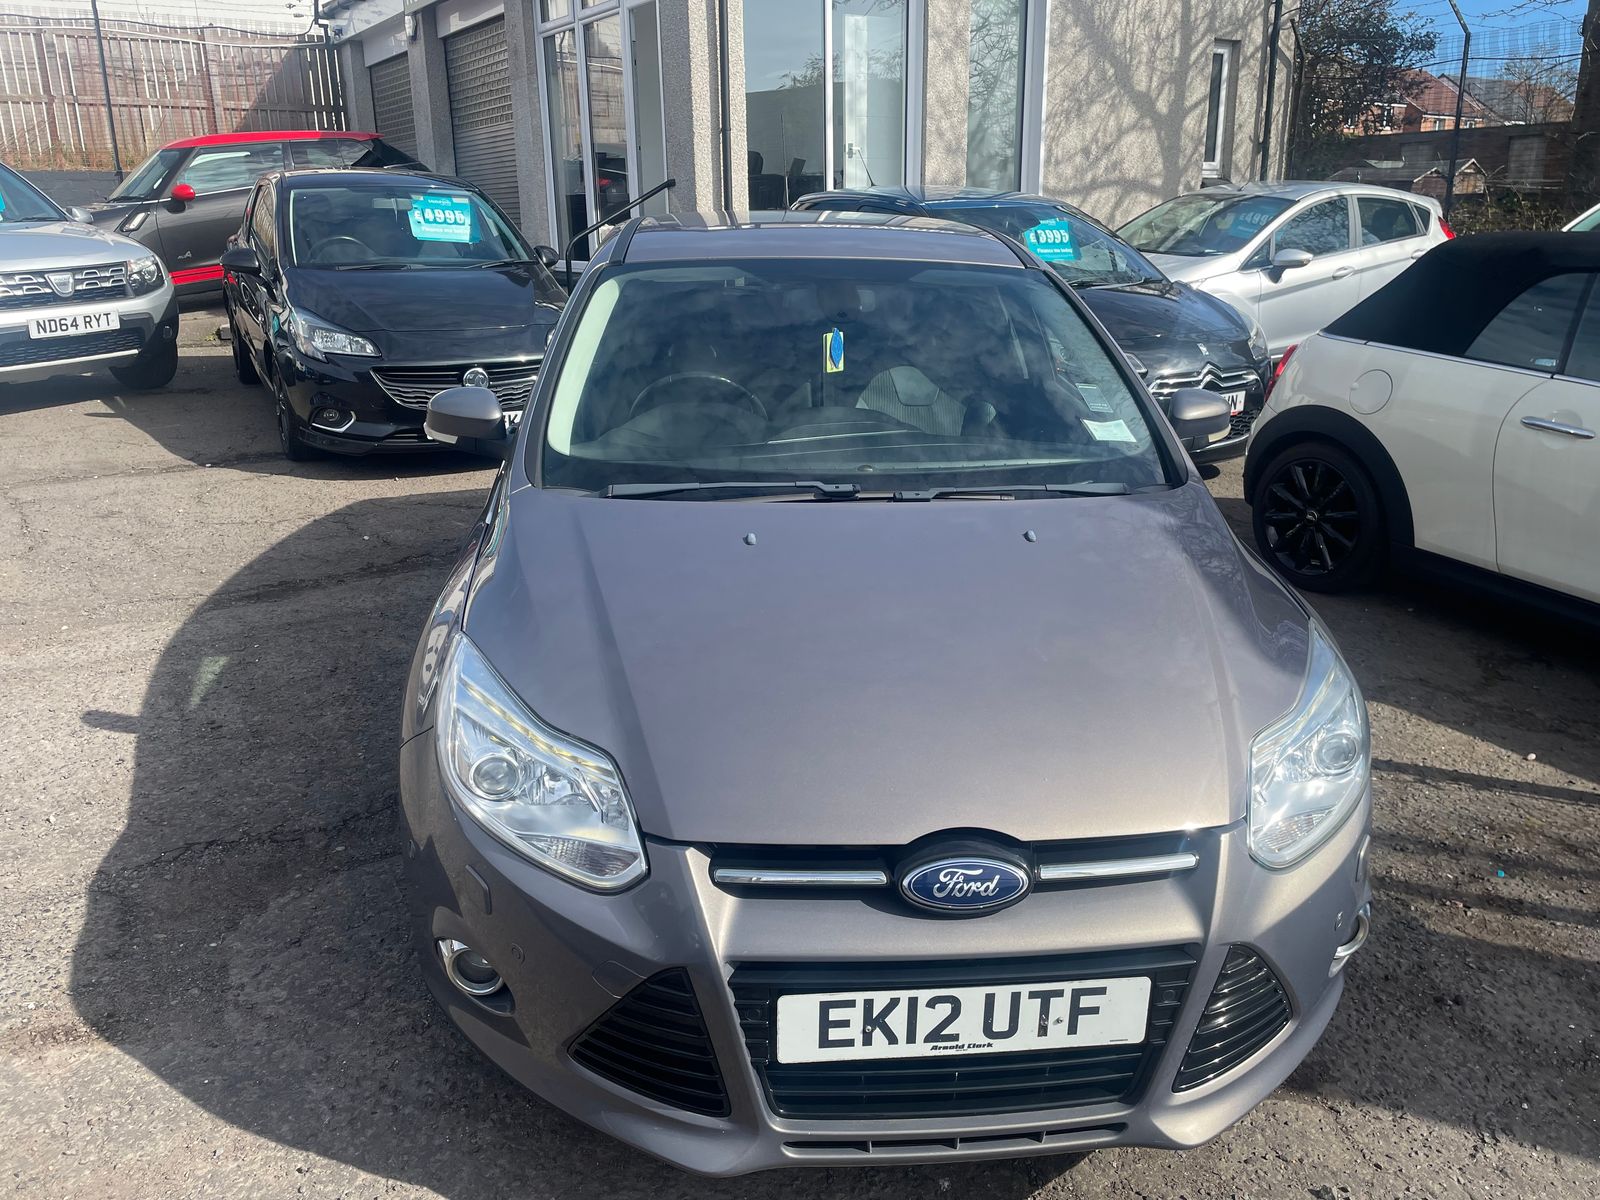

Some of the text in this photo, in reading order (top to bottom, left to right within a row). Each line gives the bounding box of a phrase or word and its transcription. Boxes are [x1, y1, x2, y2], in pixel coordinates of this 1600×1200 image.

[1239, 211, 1273, 226] £499
[36, 312, 112, 335] ND64 RYT
[932, 868, 1001, 898] Ford
[818, 986, 1108, 1049] EK12 UTF
[930, 1043, 965, 1051] Arnold
